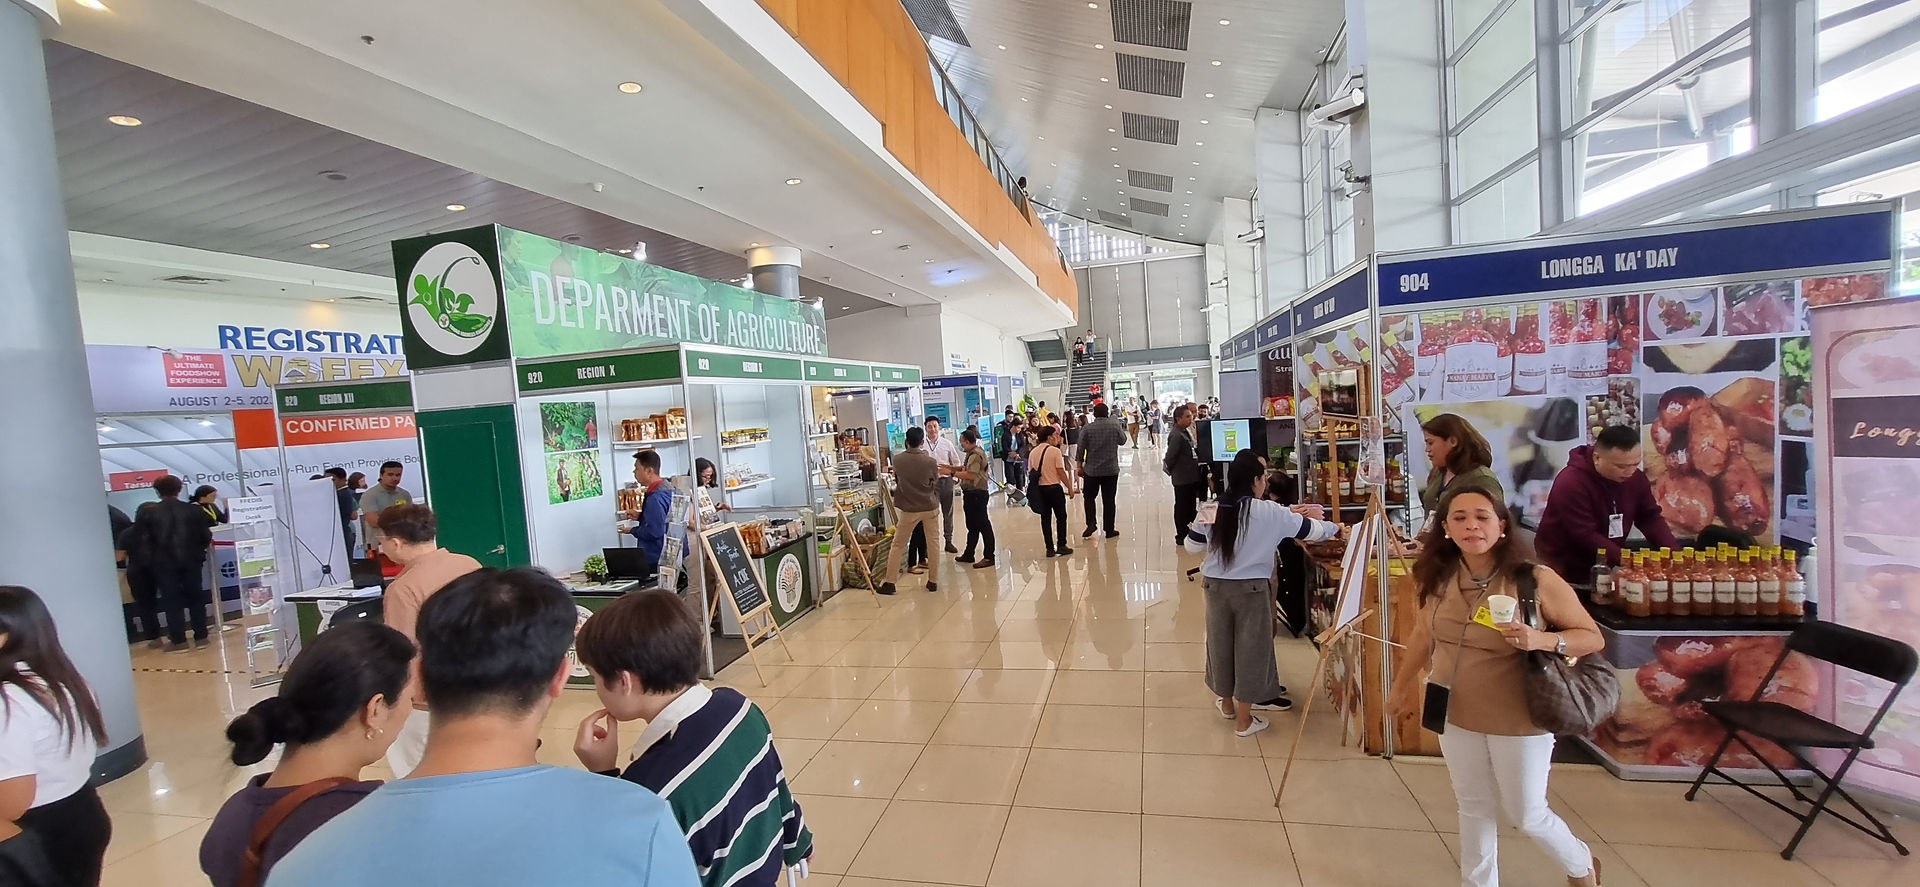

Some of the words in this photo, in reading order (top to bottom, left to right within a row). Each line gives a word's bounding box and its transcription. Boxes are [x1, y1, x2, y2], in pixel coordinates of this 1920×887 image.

[1541, 255, 1604, 280] LONGGA
[1645, 247, 1679, 269] DAY
[1400, 272, 1430, 293] 904
[530, 270, 694, 340] DEPARMENT
[700, 303, 721, 343] OF
[727, 308, 823, 356] AGRICULTURE
[527, 371, 543, 384] 920
[576, 365, 606, 380] REGION
[609, 364, 616, 377] X
[169, 377, 222, 385] EXPERIENCE
[169, 396, 218, 406] AUGUST
[250, 395, 273, 405] 202
[284, 395, 298, 407] 920
[319, 393, 343, 405] REGION
[286, 416, 391, 434] CONFIRMED
[182, 474, 193, 484] A
[232, 504, 273, 513] Registration
